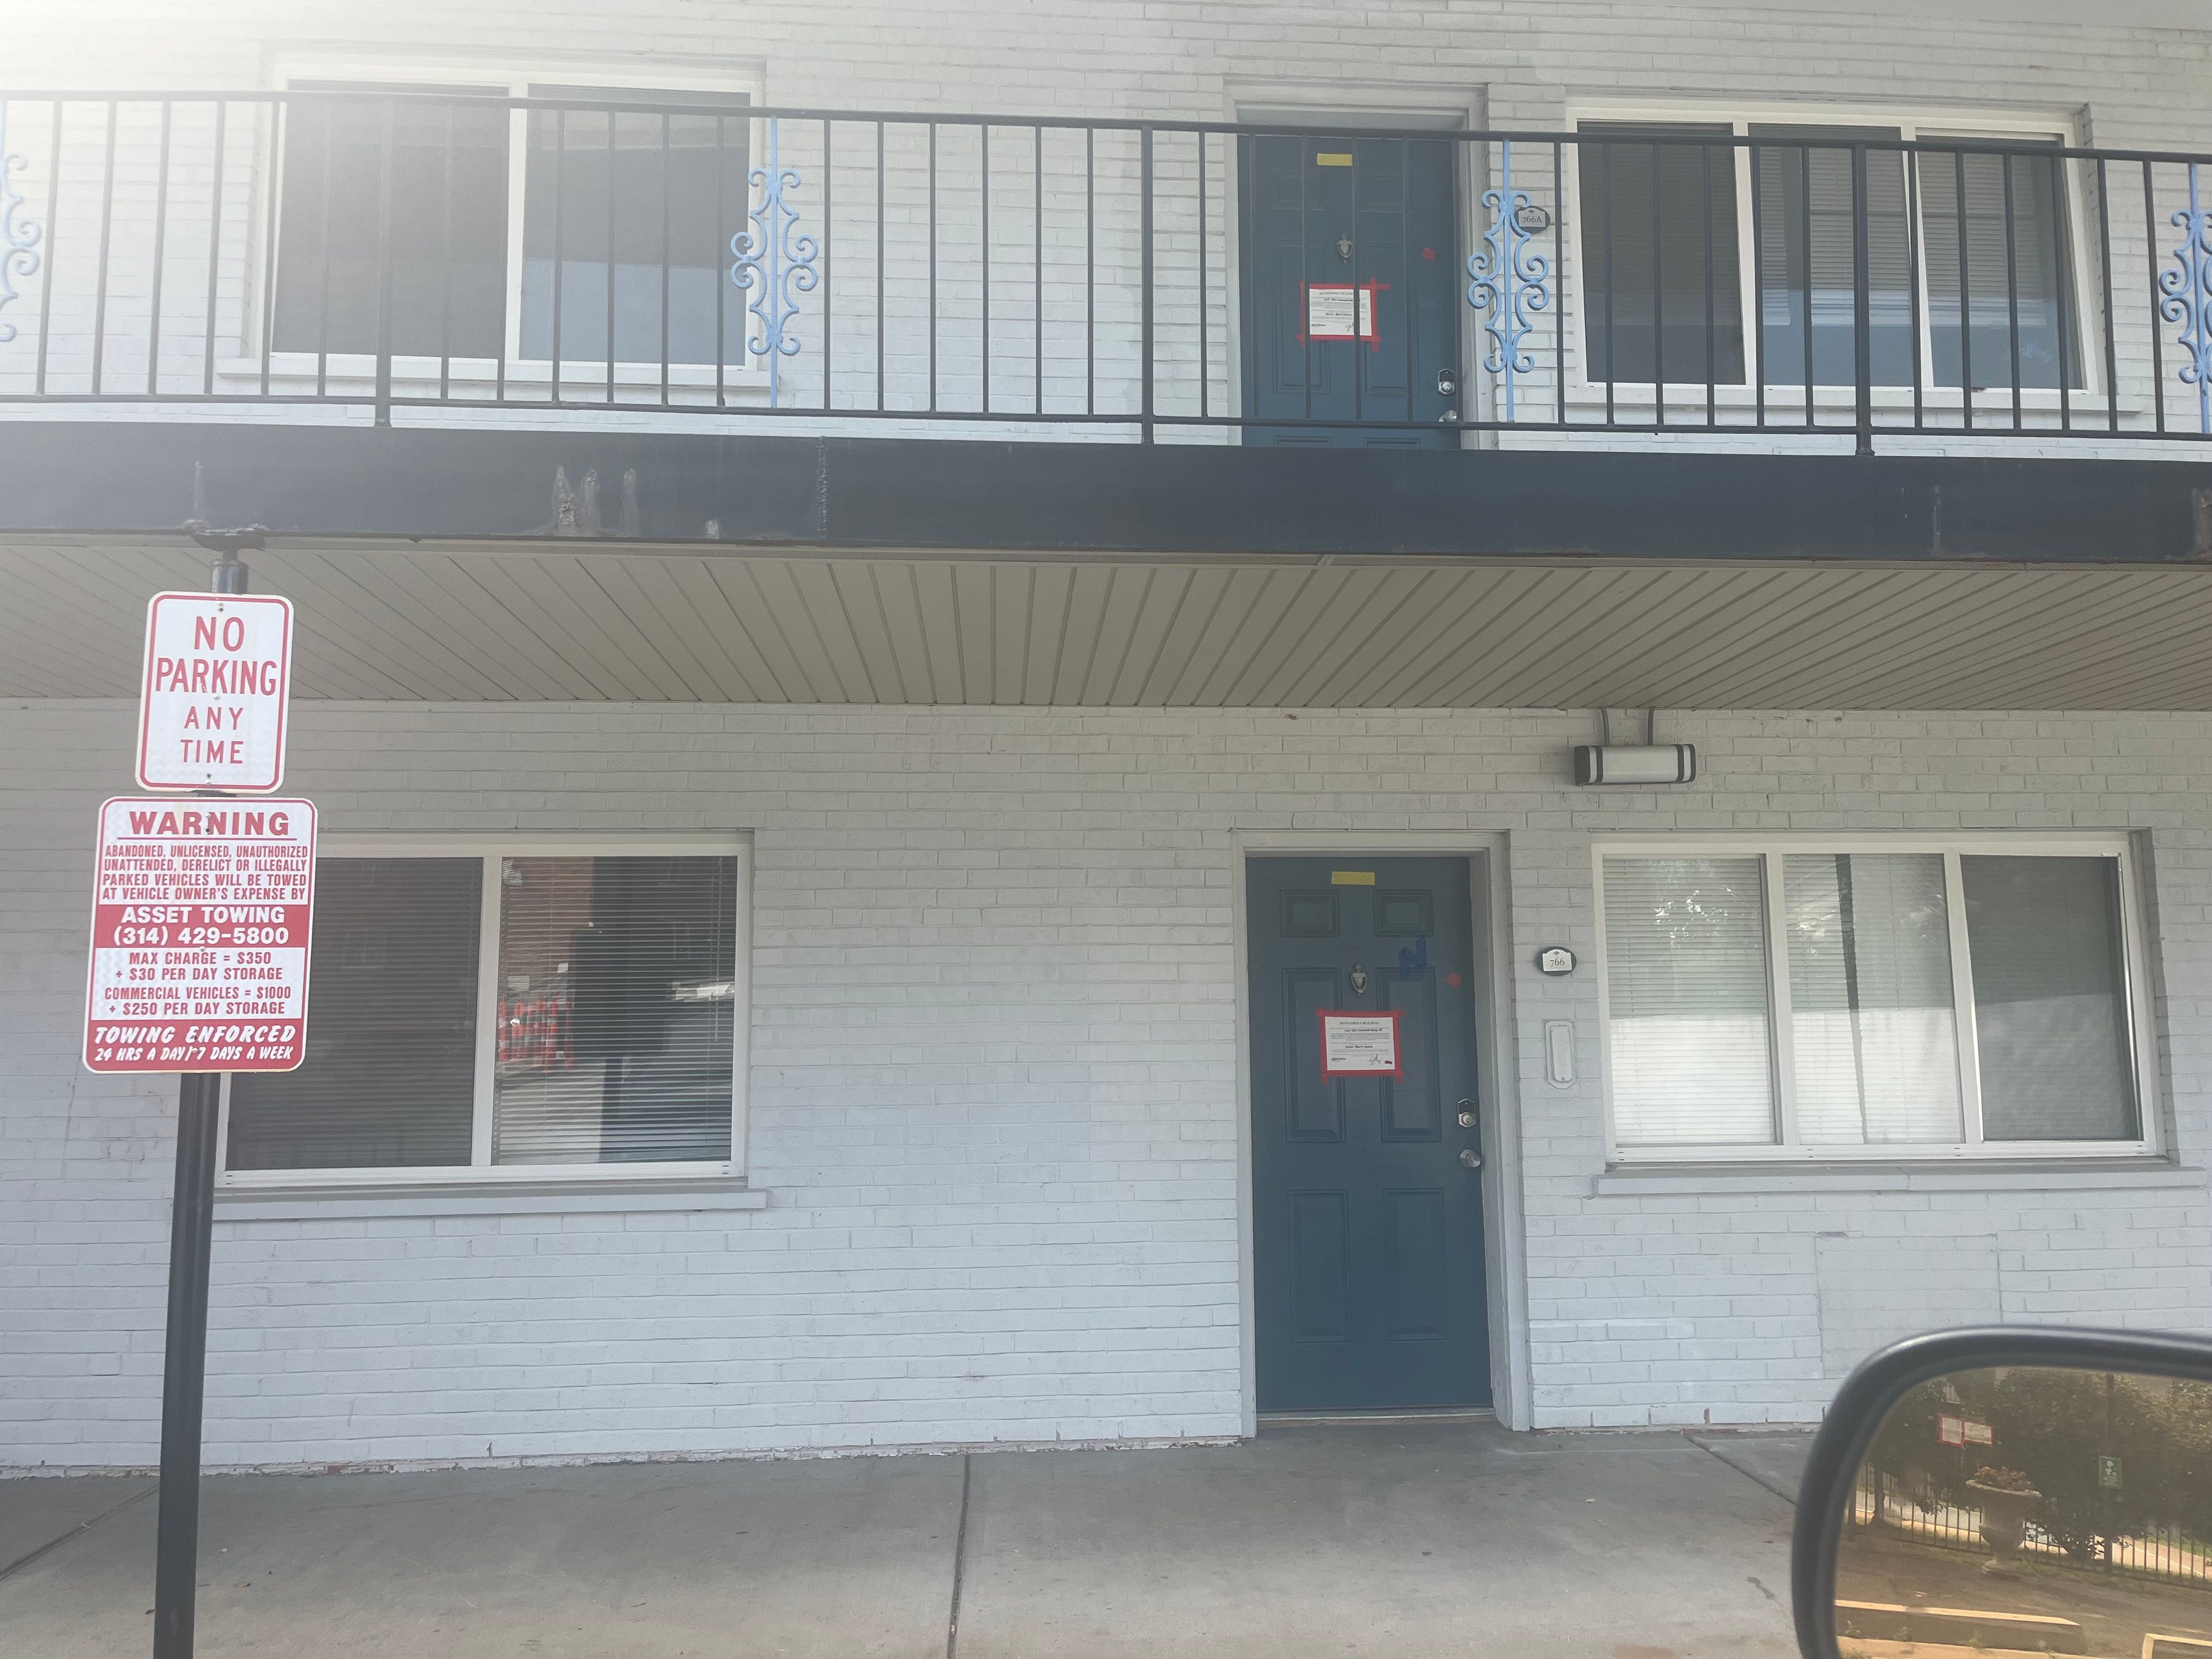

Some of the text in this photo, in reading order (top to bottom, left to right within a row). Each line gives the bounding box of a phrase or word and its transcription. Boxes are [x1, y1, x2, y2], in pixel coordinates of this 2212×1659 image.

[194, 616, 245, 652] NO
[155, 657, 277, 696] PARKING
[184, 706, 244, 730] ANY
[180, 739, 244, 764] TIME
[129, 811, 289, 836] WARNING
[105, 845, 308, 858] ABANDONED, UNLICENSED, UNAUTHORIZED
[104, 859, 307, 872] UNATTENDED, DERELICT OR ILLEGALLY
[103, 873, 306, 886] PARKED VEHICLES WILL BE TOWED
[102, 887, 306, 900] AT VEHICLE OWNER'S EXPENSE BY
[121, 906, 285, 924] ASSET TOWING
[114, 926, 289, 946] (314) 429-5800
[129, 952, 159, 964] MAX
[165, 952, 217, 964] CHARGE
[1549, 958, 1565, 968] 766
[162, 968, 186, 980] PER
[193, 968, 218, 980] DAY
[224, 967, 283, 980] STORAGE
[105, 987, 180, 1000] COMMERCIAL
[187, 987, 239, 1000] VEHICLES
[163, 1002, 188, 1015] PER
[195, 1002, 220, 1014] DAY
[226, 1002, 285, 1014] STORAGE
[95, 1025, 296, 1044] TOWING ENFORCED
[94, 1047, 112, 1061] 24
[116, 1047, 144, 1061] HRS
[146, 1047, 156, 1061] A
[210, 1046, 243, 1060] DAYS
[246, 1046, 256, 1059] A
[259, 1046, 294, 1059] WEEK
